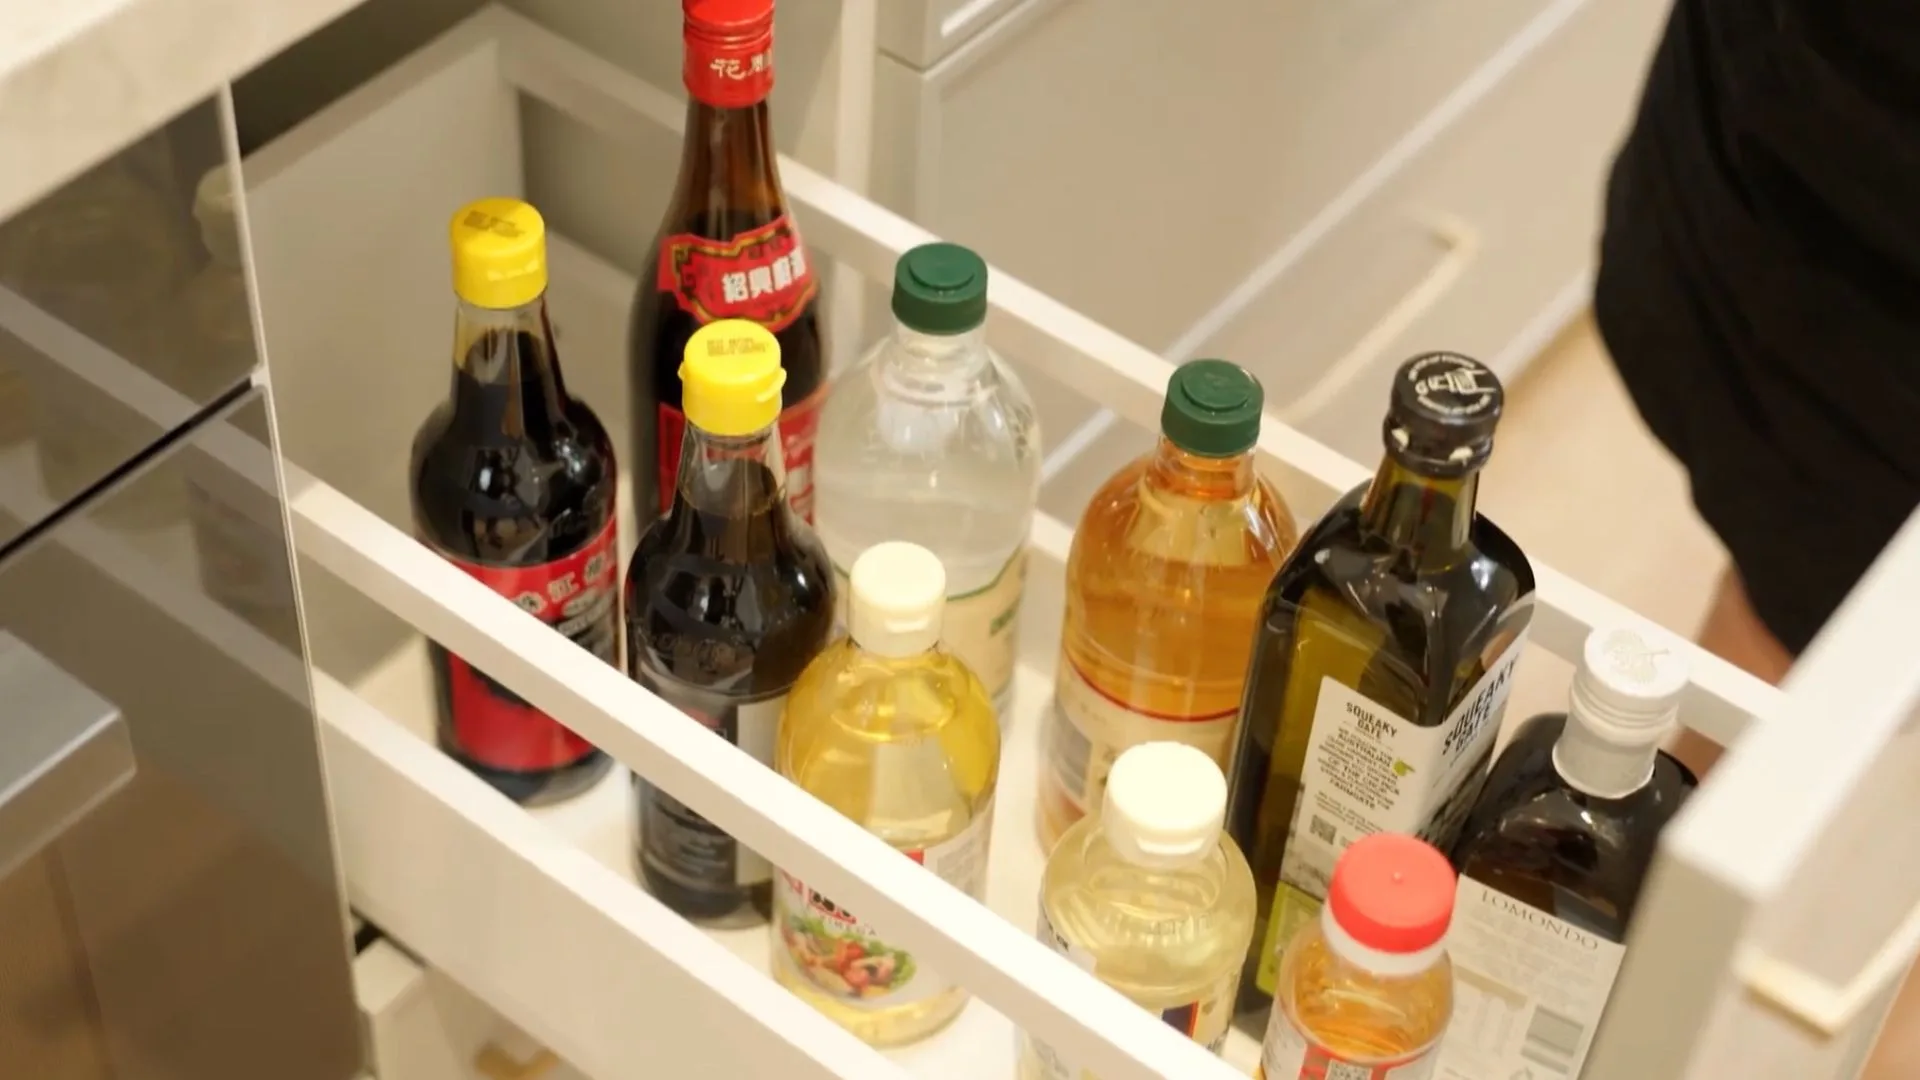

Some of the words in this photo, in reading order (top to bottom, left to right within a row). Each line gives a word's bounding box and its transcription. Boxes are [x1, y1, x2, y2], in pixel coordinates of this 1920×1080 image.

[1346, 702, 1398, 738] SQUEAKY
[1442, 652, 1519, 756] SQUEAKY
[1357, 718, 1384, 740] GATE
[1337, 733, 1390, 768] AUSTRALIAN
[1343, 765, 1359, 779] THE
